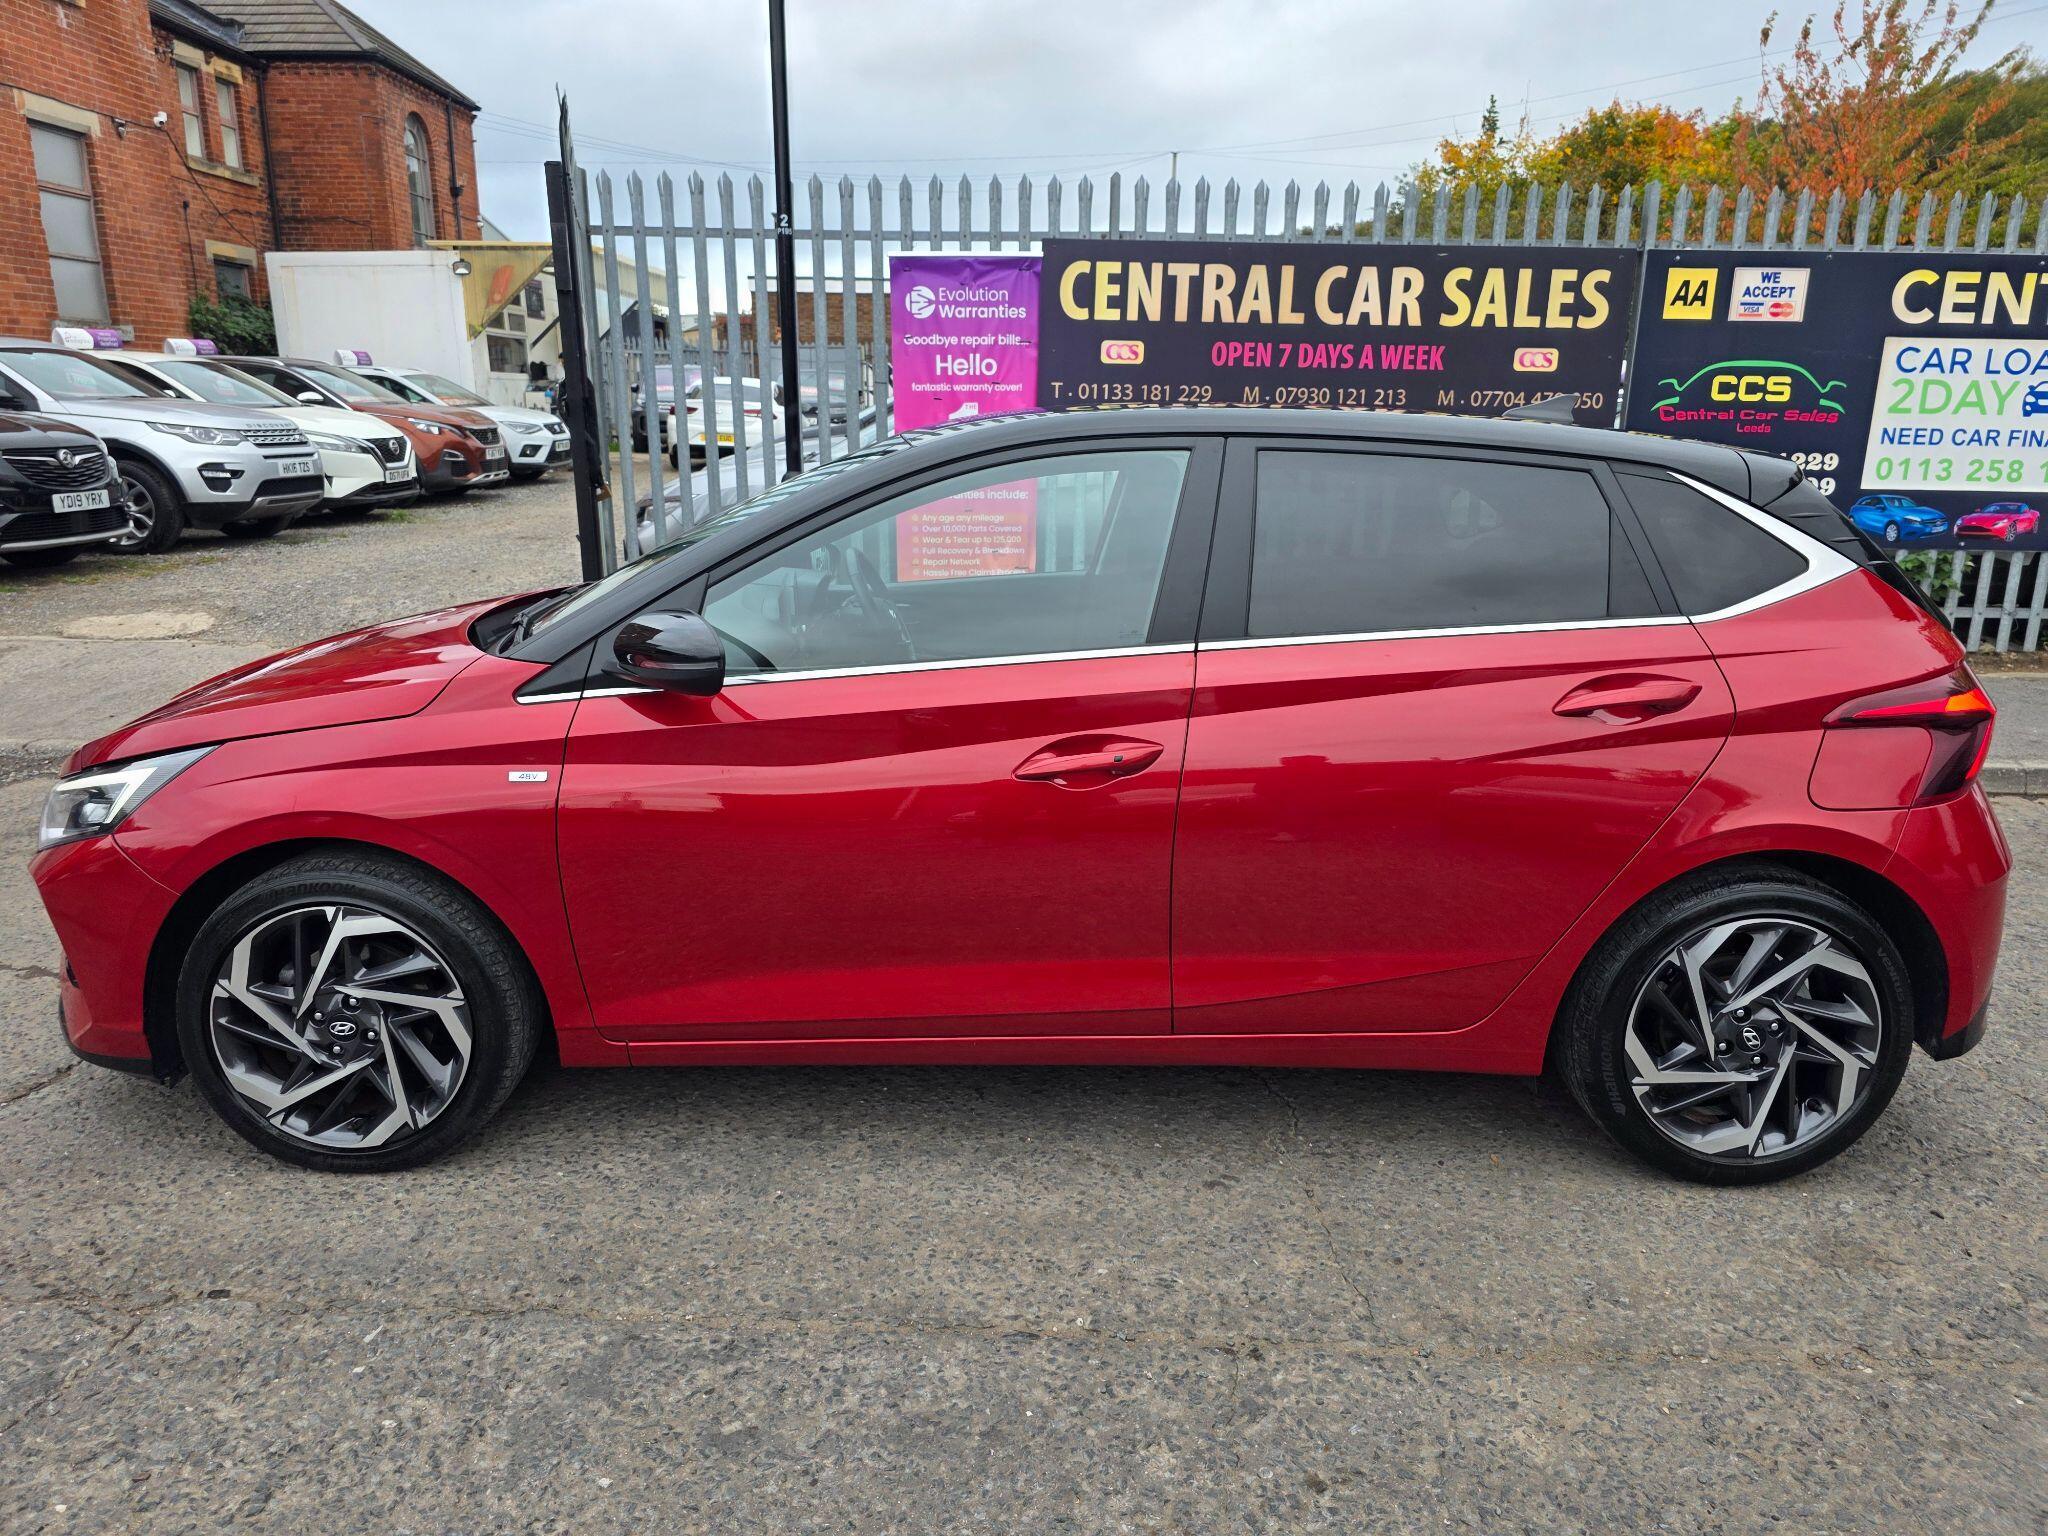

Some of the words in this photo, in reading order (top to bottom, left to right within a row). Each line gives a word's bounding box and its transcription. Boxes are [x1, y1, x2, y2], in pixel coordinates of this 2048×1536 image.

[780, 214, 789, 227] 2
[1761, 272, 1781, 284] WE
[939, 287, 1009, 301] Evolution
[1059, 260, 1305, 325] CENTRAL
[1314, 265, 1425, 326] CAR
[1439, 267, 1613, 330] SALES
[1670, 280, 1709, 307] AA
[1742, 286, 1796, 298] ACCEPT
[1891, 269, 2048, 325] CEN
[939, 304, 1027, 318] Warranties
[904, 334, 958, 348] Goodbye
[961, 334, 995, 348] repair
[1211, 341, 1272, 367] OPEN
[1279, 344, 1293, 367] 7
[1298, 343, 1353, 369] DAYS
[1359, 345, 1374, 369] A
[1380, 345, 1446, 370] WEEK
[1896, 346, 1973, 374] CAR
[936, 353, 998, 376] Hello
[912, 382, 951, 392] fantastic
[953, 383, 993, 394] warranty
[995, 383, 1023, 392] cover!
[1078, 383, 1133, 400] 01133
[1141, 384, 1171, 401] 181
[1178, 385, 1212, 402] 229
[1275, 387, 1330, 404] 07930
[1337, 388, 1366, 405] 121
[1374, 389, 1407, 405] 213
[1711, 375, 1792, 402] CCS
[1471, 391, 1525, 407] 07704
[1531, 392, 1562, 405] 47
[1887, 378, 2021, 416] 2DAY
[1659, 406, 1734, 421] Central
[1740, 410, 1779, 421] Car
[1783, 409, 1839, 423] Sales
[1736, 423, 1771, 433] Leeds
[1880, 427, 1944, 445] NEED
[1951, 428, 2001, 446] CAR
[1791, 453, 1839, 471] 229
[1875, 457, 1953, 482] 0113
[1966, 458, 2024, 483] 258
[59, 495, 83, 509] YD19
[85, 492, 104, 506] YRX
[988, 489, 1029, 500] include:
[922, 514, 936, 523] Any
[956, 515, 971, 523] any
[972, 514, 1004, 522] mileage
[922, 525, 941, 533] Over
[923, 536, 943, 544] Wear
[973, 537, 982, 545] up
[937, 547, 973, 556] Recovery
[923, 558, 948, 567] Repair
[950, 558, 980, 566] Network
